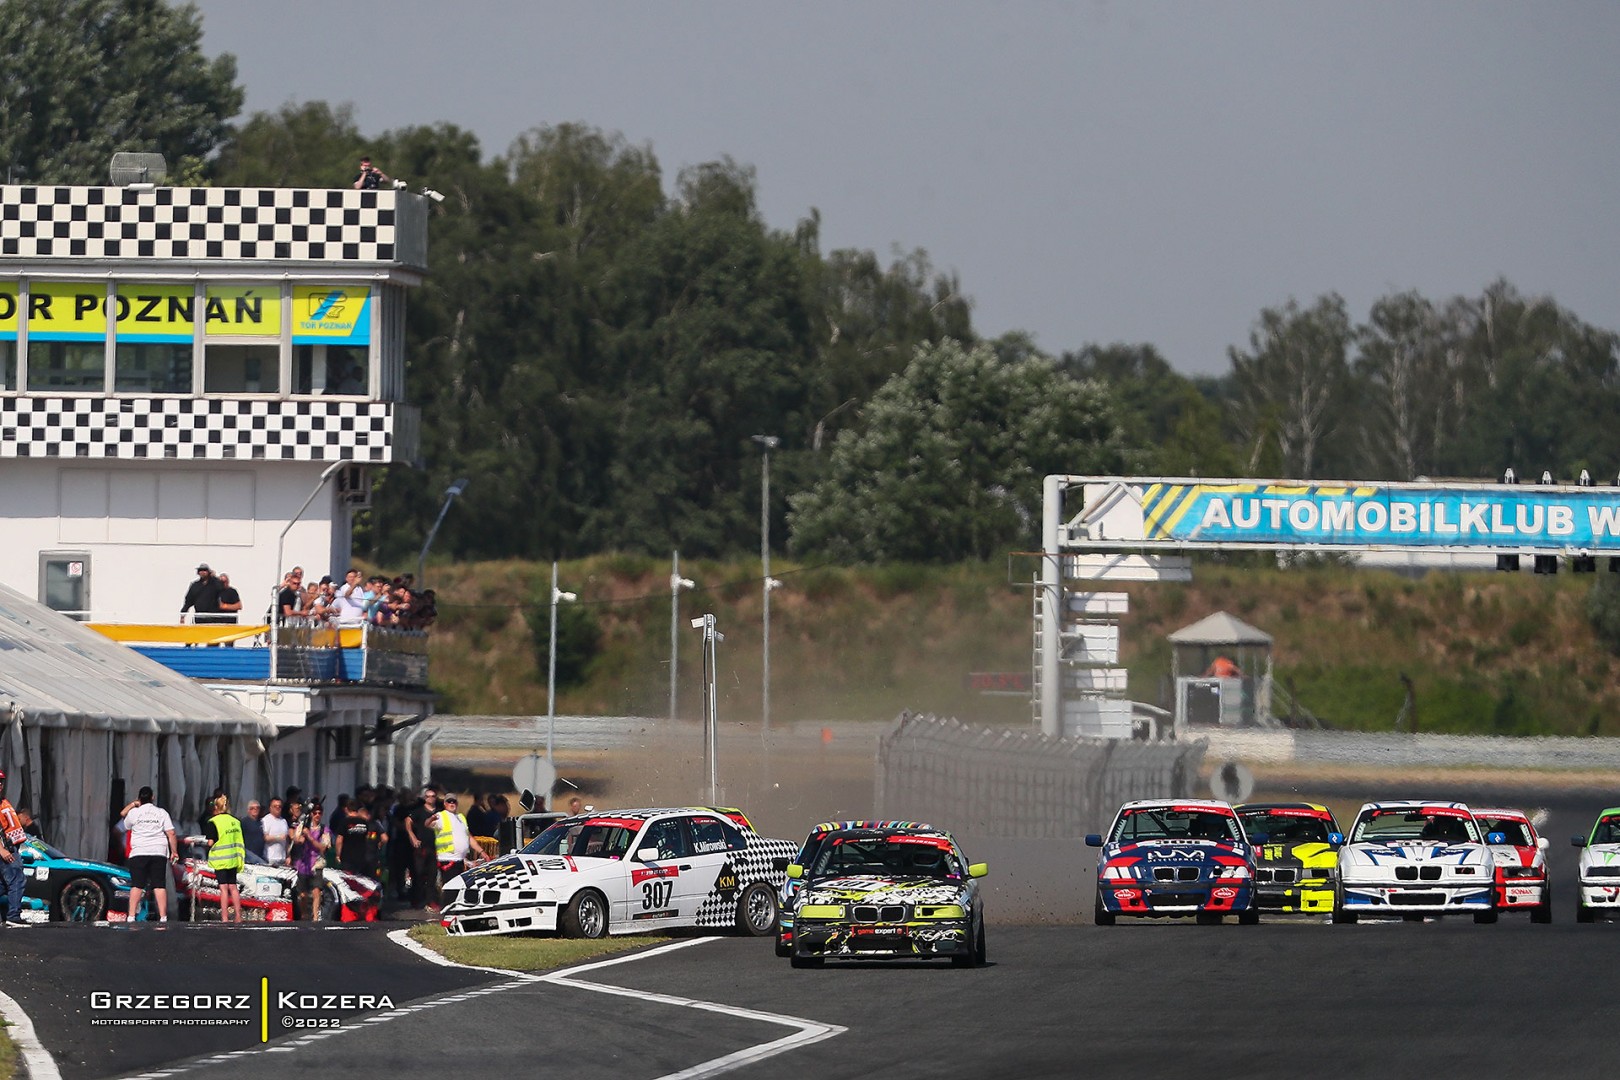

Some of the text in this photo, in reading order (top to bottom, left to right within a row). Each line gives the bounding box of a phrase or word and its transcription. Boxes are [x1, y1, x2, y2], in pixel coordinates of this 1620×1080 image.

[74, 290, 263, 323] POZNAŃ
[300, 321, 316, 329] TOR
[1201, 497, 1574, 536] AUTOMOBILKLUB
[693, 838, 728, 854] K.Mirowski
[719, 876, 735, 888] KM
[642, 880, 673, 910] 307
